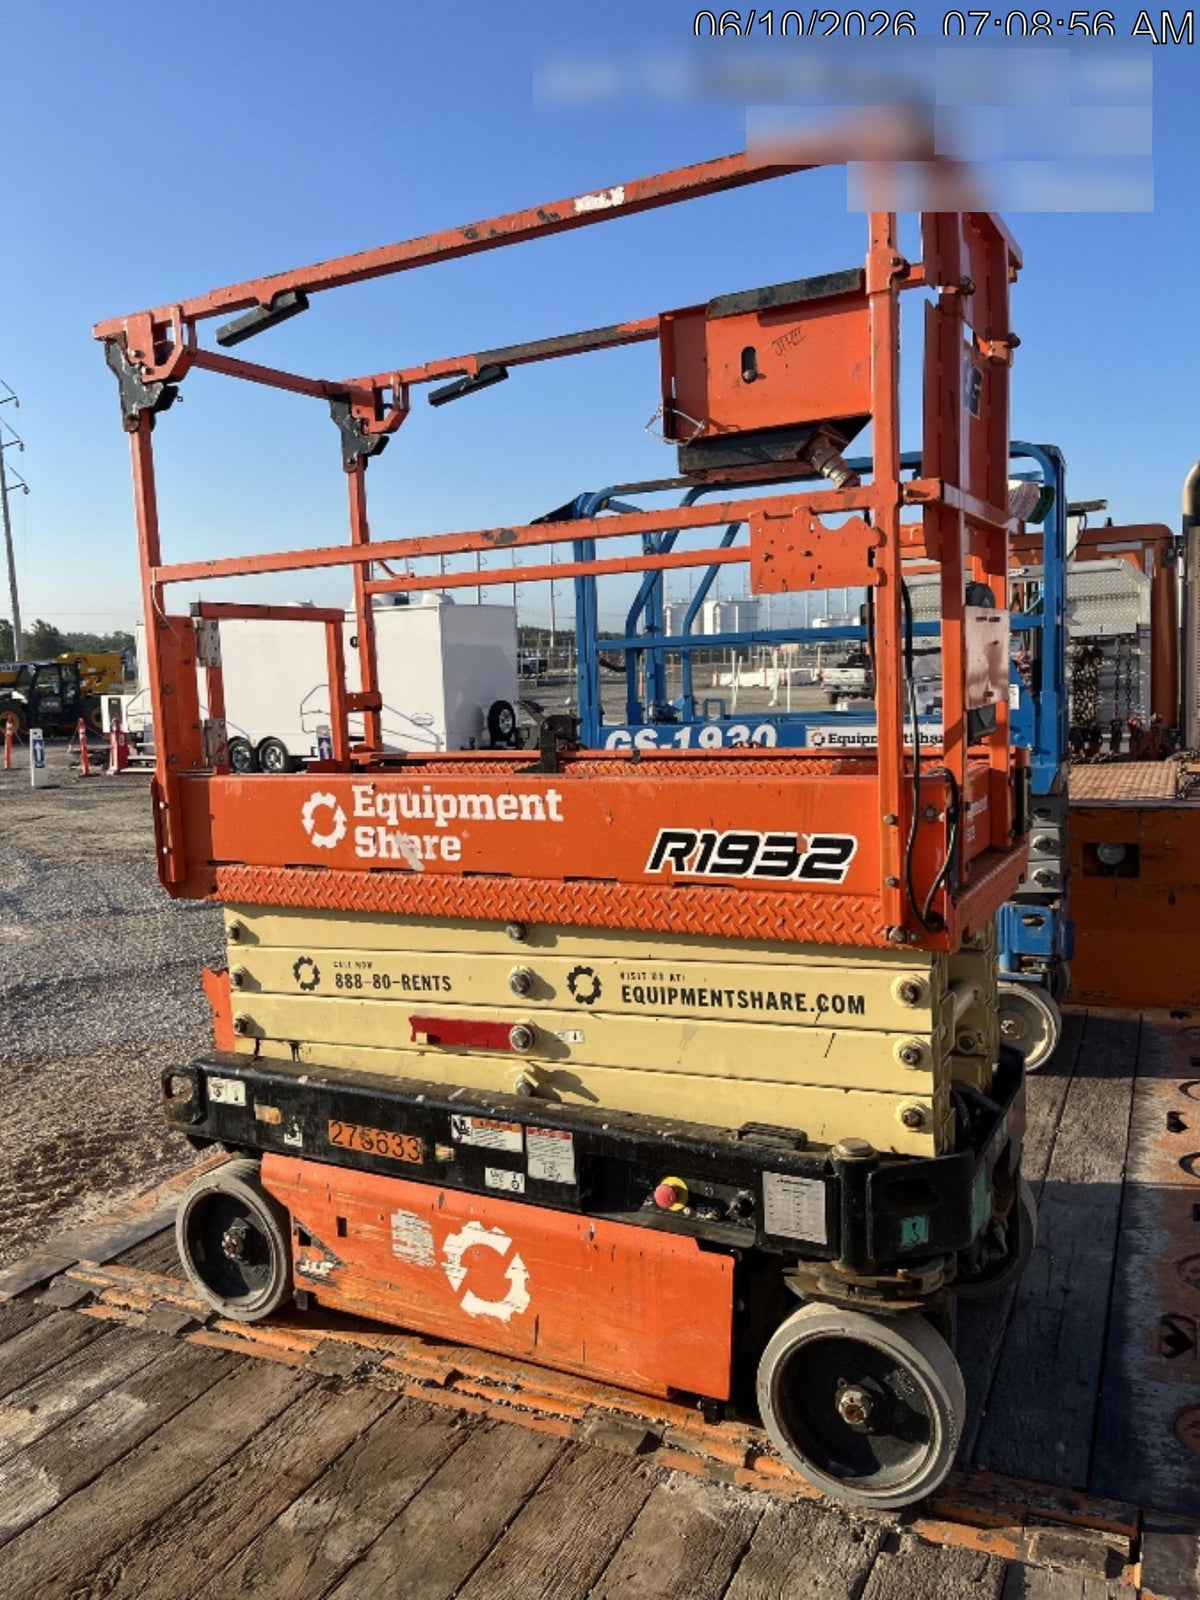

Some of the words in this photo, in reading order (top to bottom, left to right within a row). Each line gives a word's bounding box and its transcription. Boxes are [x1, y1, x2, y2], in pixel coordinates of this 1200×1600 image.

[352, 784, 564, 827] Equipment
[354, 826, 462, 862] Share
[645, 827, 857, 884] R1932
[335, 973, 452, 992] 888-80-RENTS
[621, 985, 866, 1016] EQUIPMENTSHARE.COM
